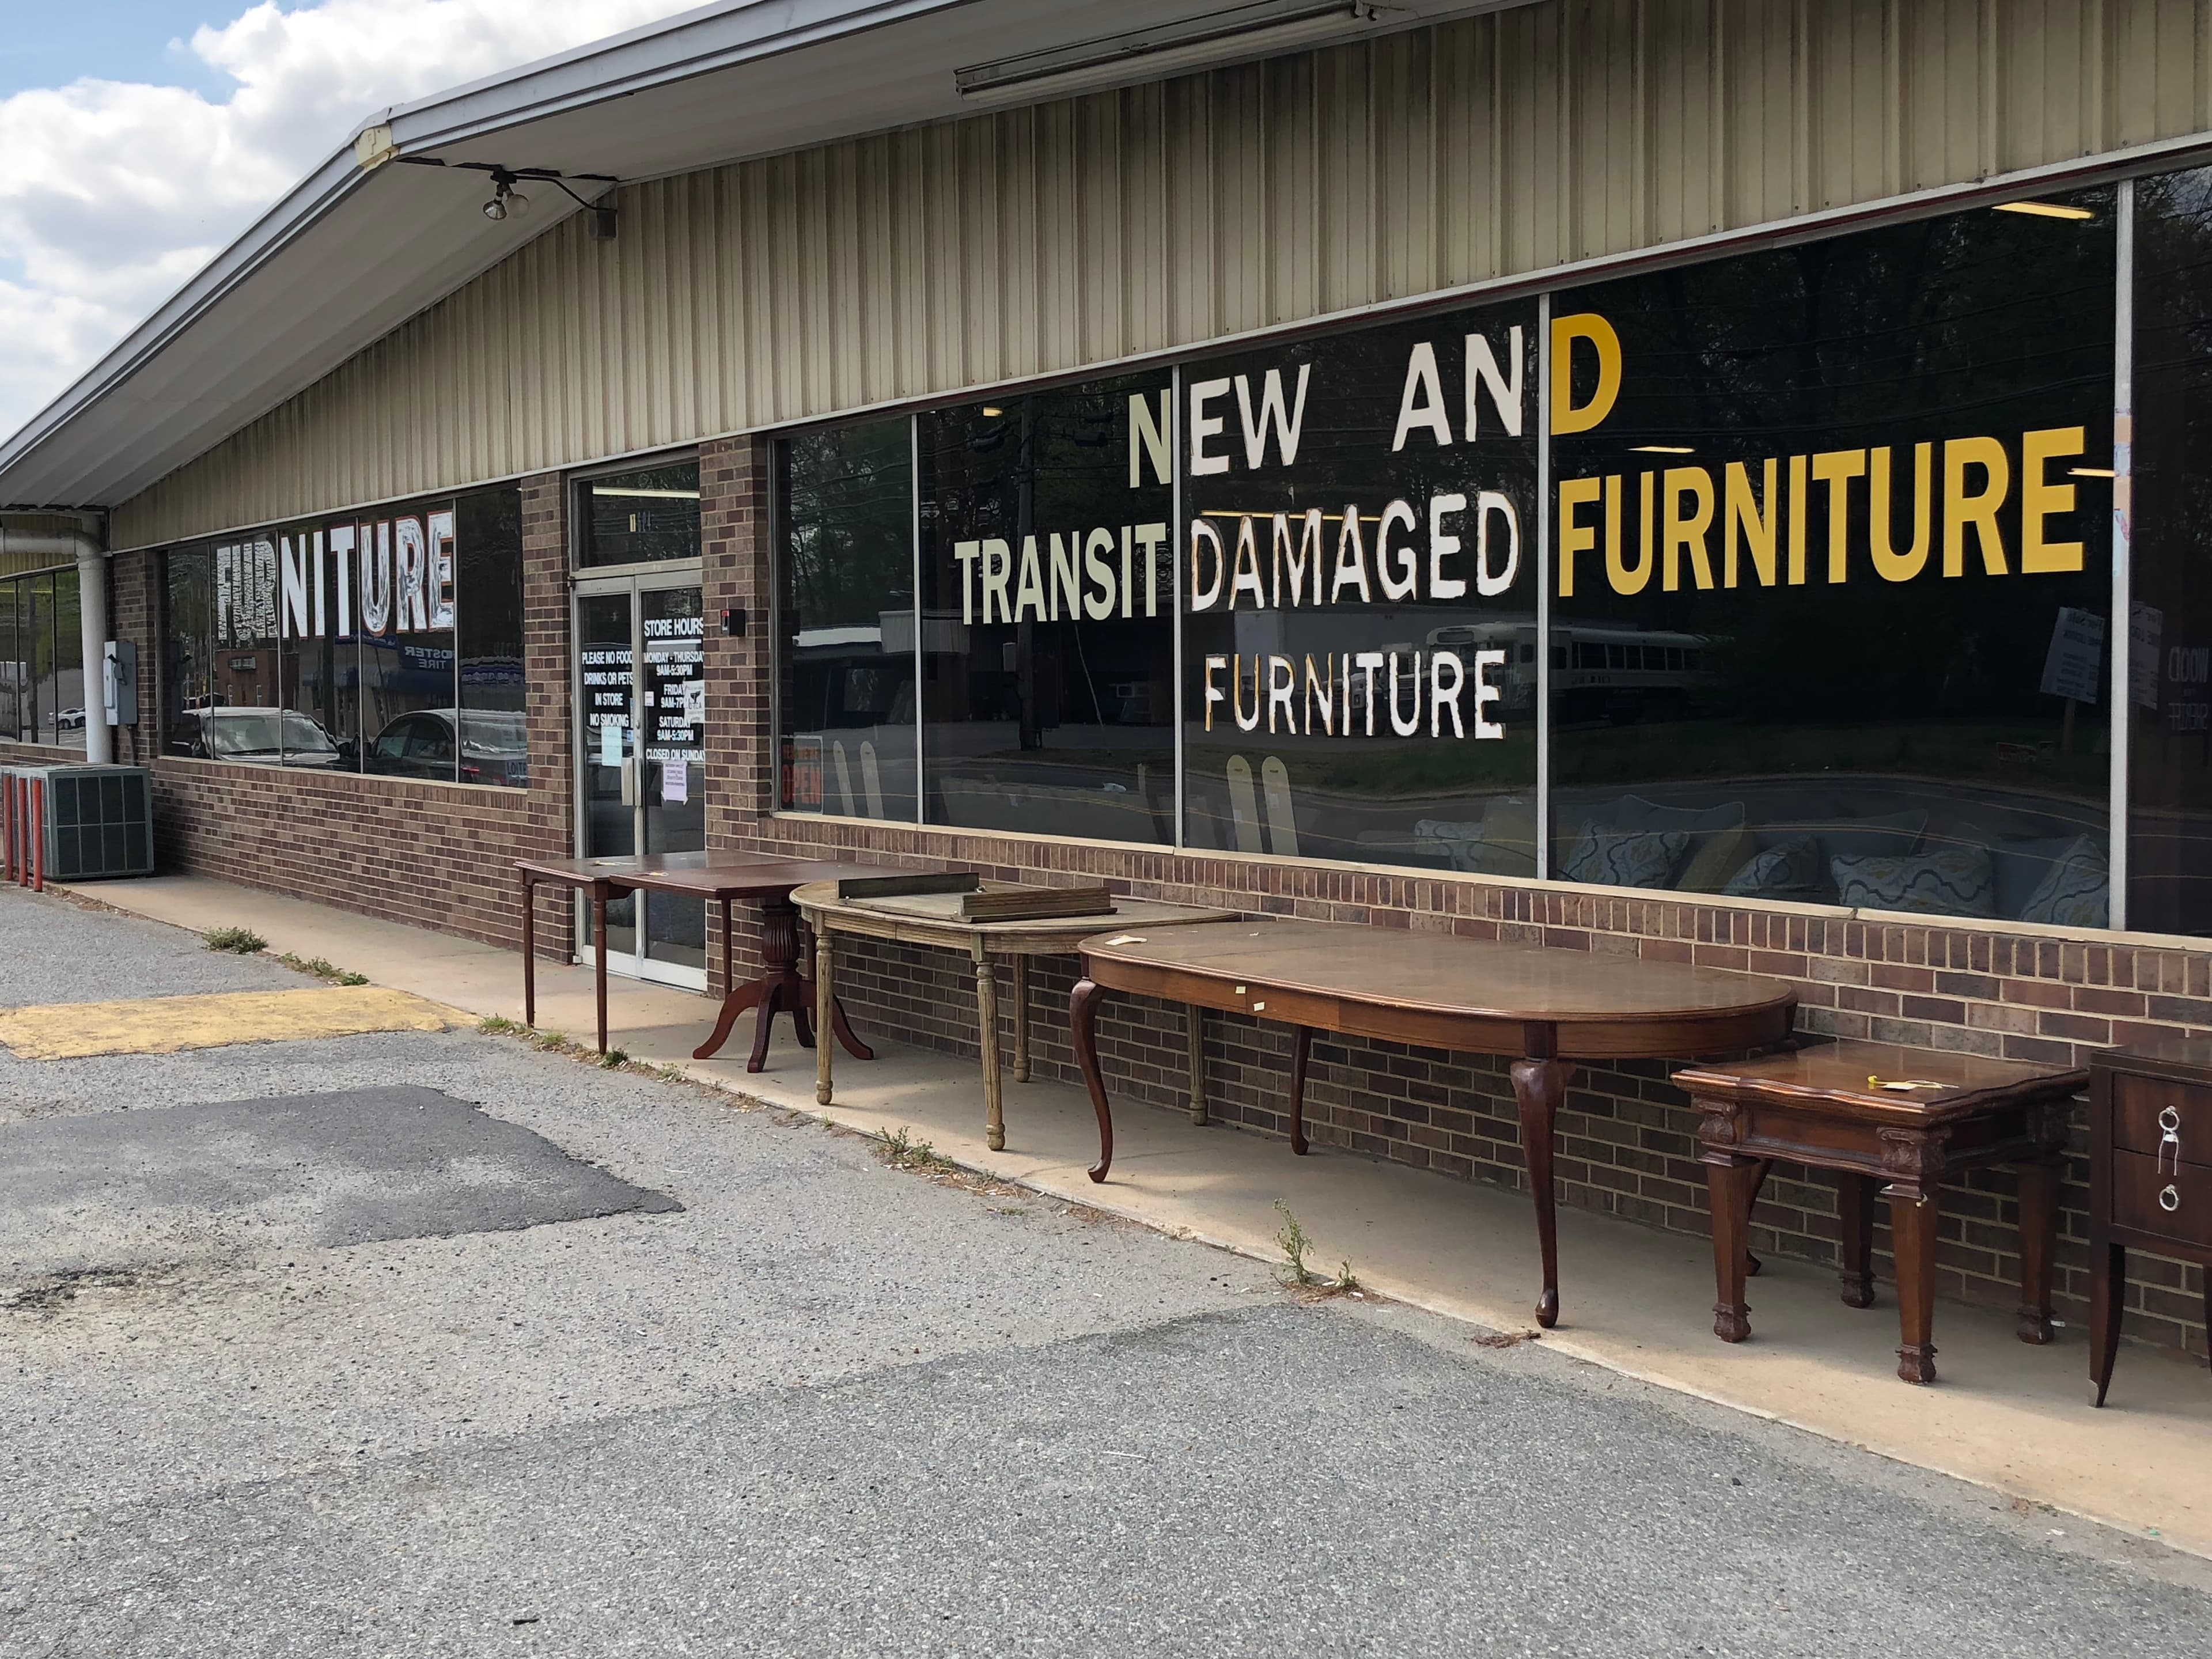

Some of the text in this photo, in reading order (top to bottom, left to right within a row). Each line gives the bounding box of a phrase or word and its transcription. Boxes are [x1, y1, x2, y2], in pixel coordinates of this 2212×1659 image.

[1129, 313, 1622, 488] NEW AND
[954, 426, 2085, 625] TRANSIT DAMAGED FURNITURE
[217, 510, 454, 641] FURNITURE
[644, 617, 704, 637] STORE HOURS
[582, 650, 632, 664] PLEASE NO FOOD
[643, 652, 669, 664] MONDAY
[673, 650, 704, 662] THURSDA
[657, 664, 693, 676] 9AM-5:30PM
[584, 672, 633, 685] DRINKS OR PETS
[664, 684, 687, 695] FRIDAY
[1205, 649, 1506, 740] FURNITURE
[594, 692, 623, 706] IN STORE
[661, 697, 689, 709] 9AM-7PM
[590, 713, 630, 727] NO SMOKING
[659, 716, 692, 728] SATURDAY
[657, 729, 694, 741] 9AM-5:30PM
[646, 748, 670, 760] CLOSED
[671, 749, 680, 760] ON
[782, 764, 821, 805] OPEN
